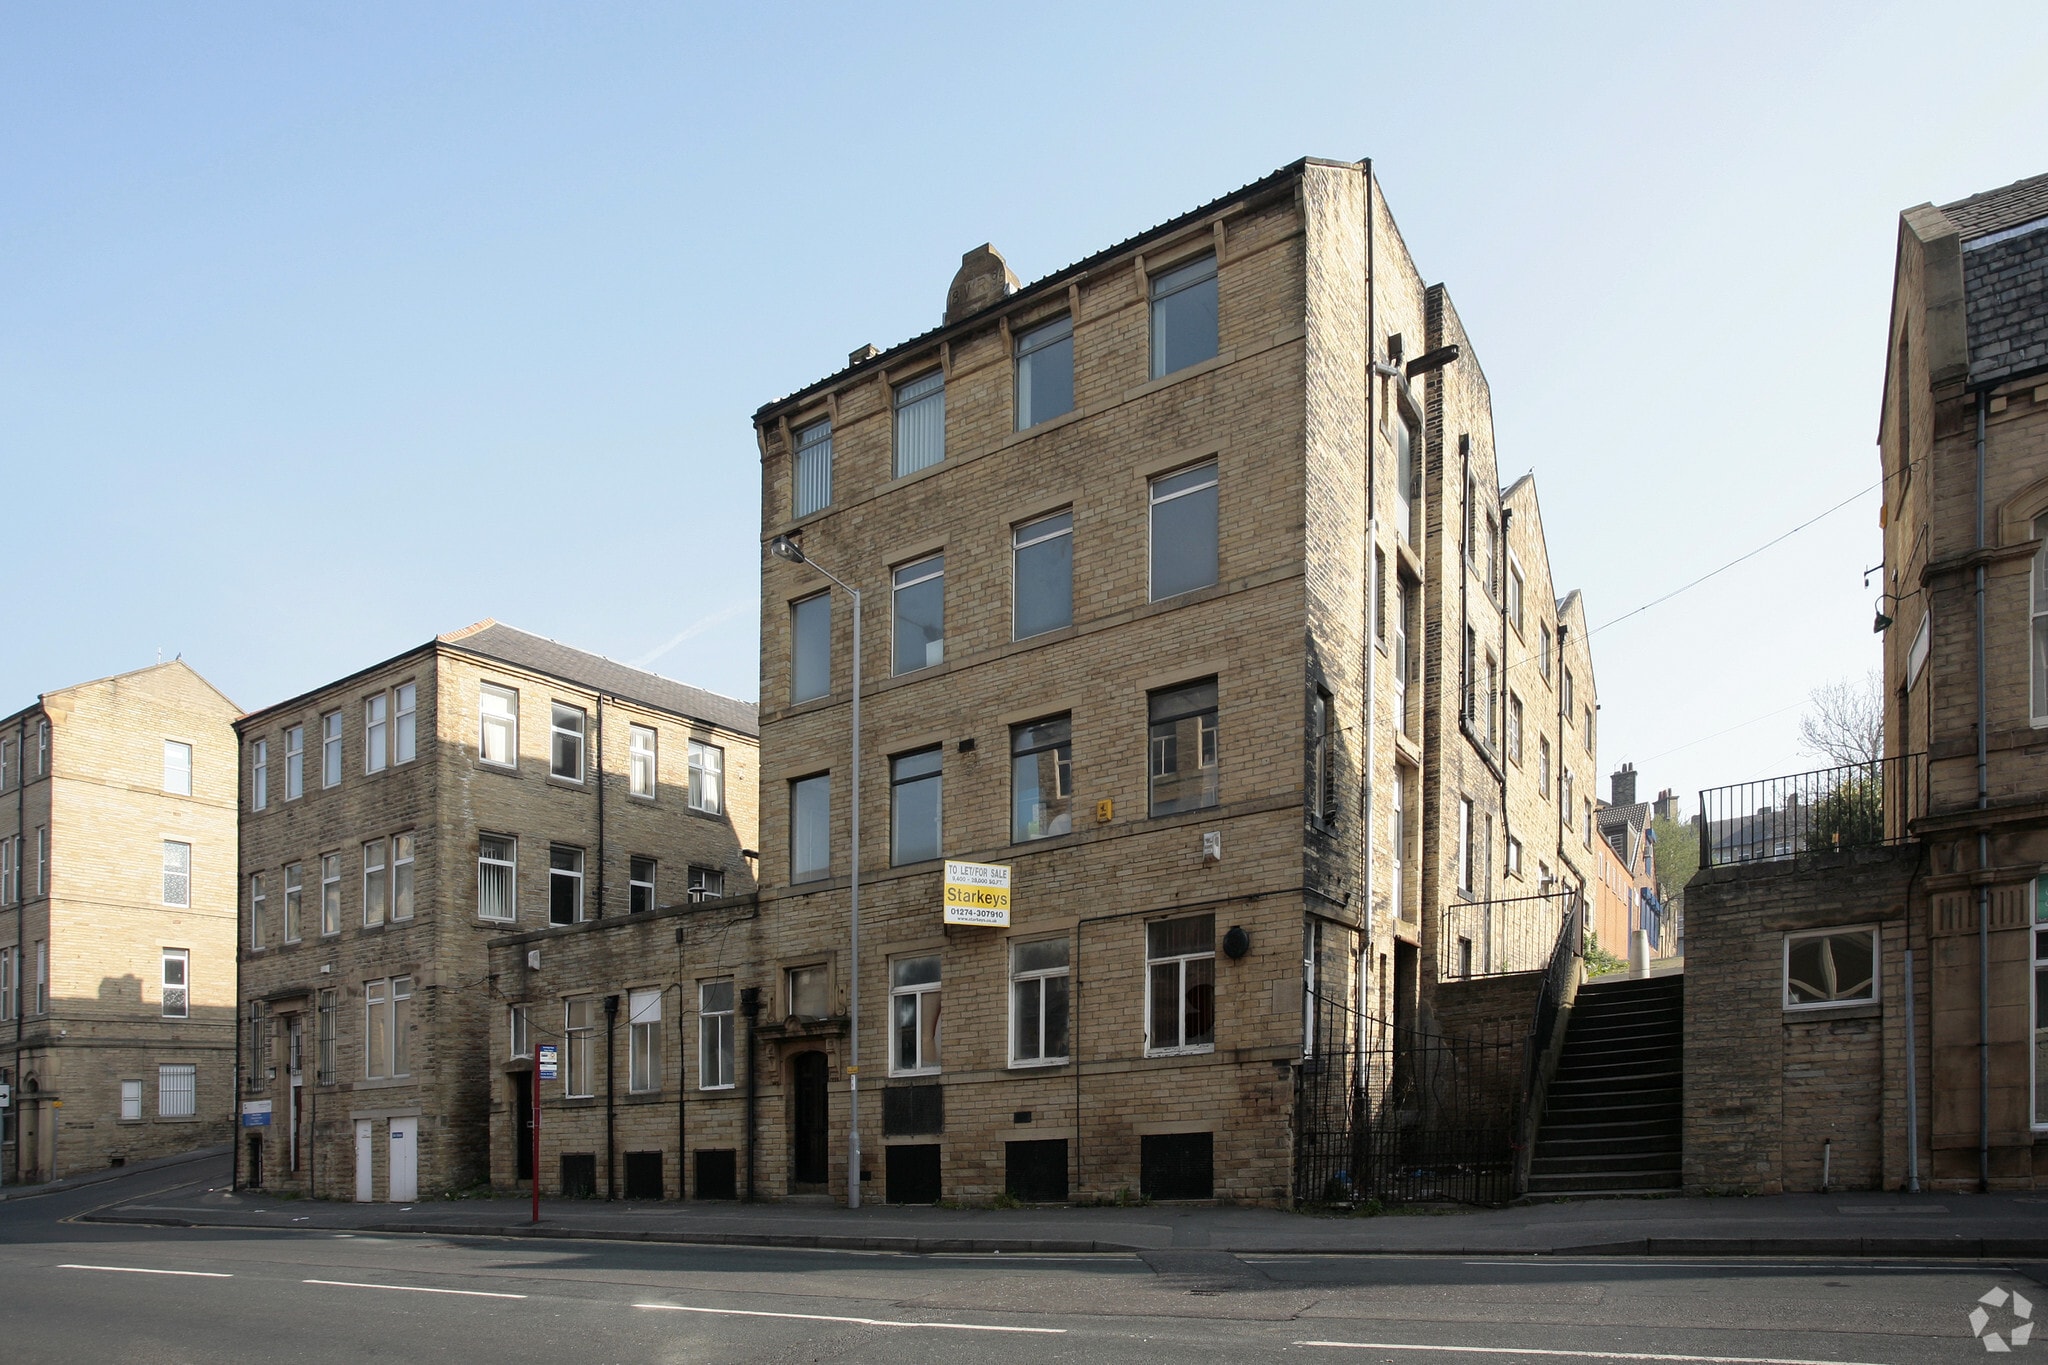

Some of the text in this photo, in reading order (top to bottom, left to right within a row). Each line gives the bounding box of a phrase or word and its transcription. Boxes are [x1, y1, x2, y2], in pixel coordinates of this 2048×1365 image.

[948, 864, 1007, 879] TO LET/FOR SALE
[947, 887, 1008, 907] Starkeys
[950, 908, 1004, 918] 01274-307910
